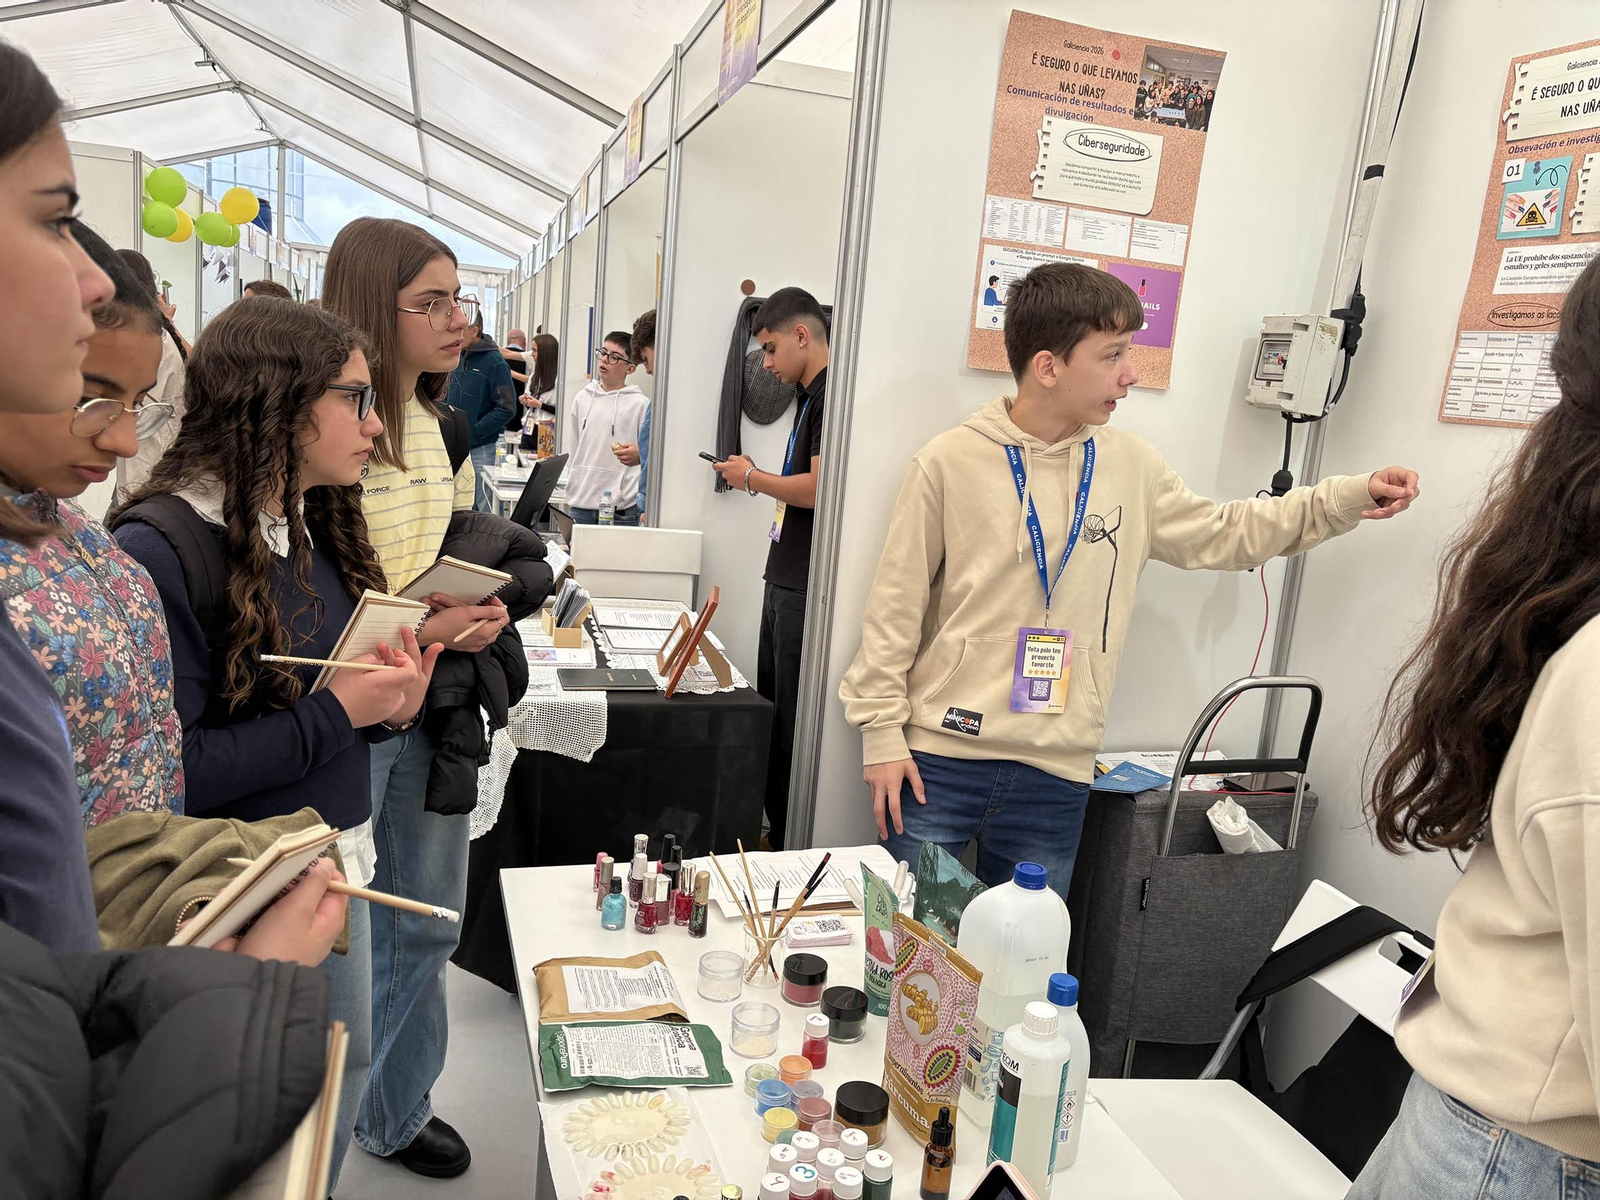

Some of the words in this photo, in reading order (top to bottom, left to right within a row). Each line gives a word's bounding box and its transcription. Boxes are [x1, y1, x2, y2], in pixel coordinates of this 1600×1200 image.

[1032, 51, 1038, 65] É
[1040, 55, 1071, 72] SEGURO
[1073, 62, 1079, 73] O
[1082, 63, 1098, 78] QUE
[1100, 66, 1138, 85] LEVAMOS
[1059, 81, 1076, 96] NAS
[1078, 83, 1106, 100] UÑAS?
[1531, 86, 1538, 101] É
[1540, 81, 1575, 100] SEGURO
[1577, 79, 1585, 93] O
[1006, 84, 1068, 105] Comunicación
[1069, 95, 1082, 107] de
[1082, 98, 1127, 115] resultados
[1129, 107, 1134, 115] e
[1045, 106, 1094, 123] divulgación
[1560, 103, 1580, 118] NAS
[1078, 133, 1146, 157] Ciberseguridade
[1508, 141, 1557, 155] Obsevación
[1506, 164, 1521, 177] 01
[1550, 261, 1589, 269] semiperma
[1491, 309, 1536, 321] Investigamos
[410, 477, 427, 486] RAW
[1027, 645, 1040, 653] Vota
[1040, 646, 1051, 654] polo
[879, 967, 894, 982] ROS
[679, 1026, 697, 1051] Gomma
